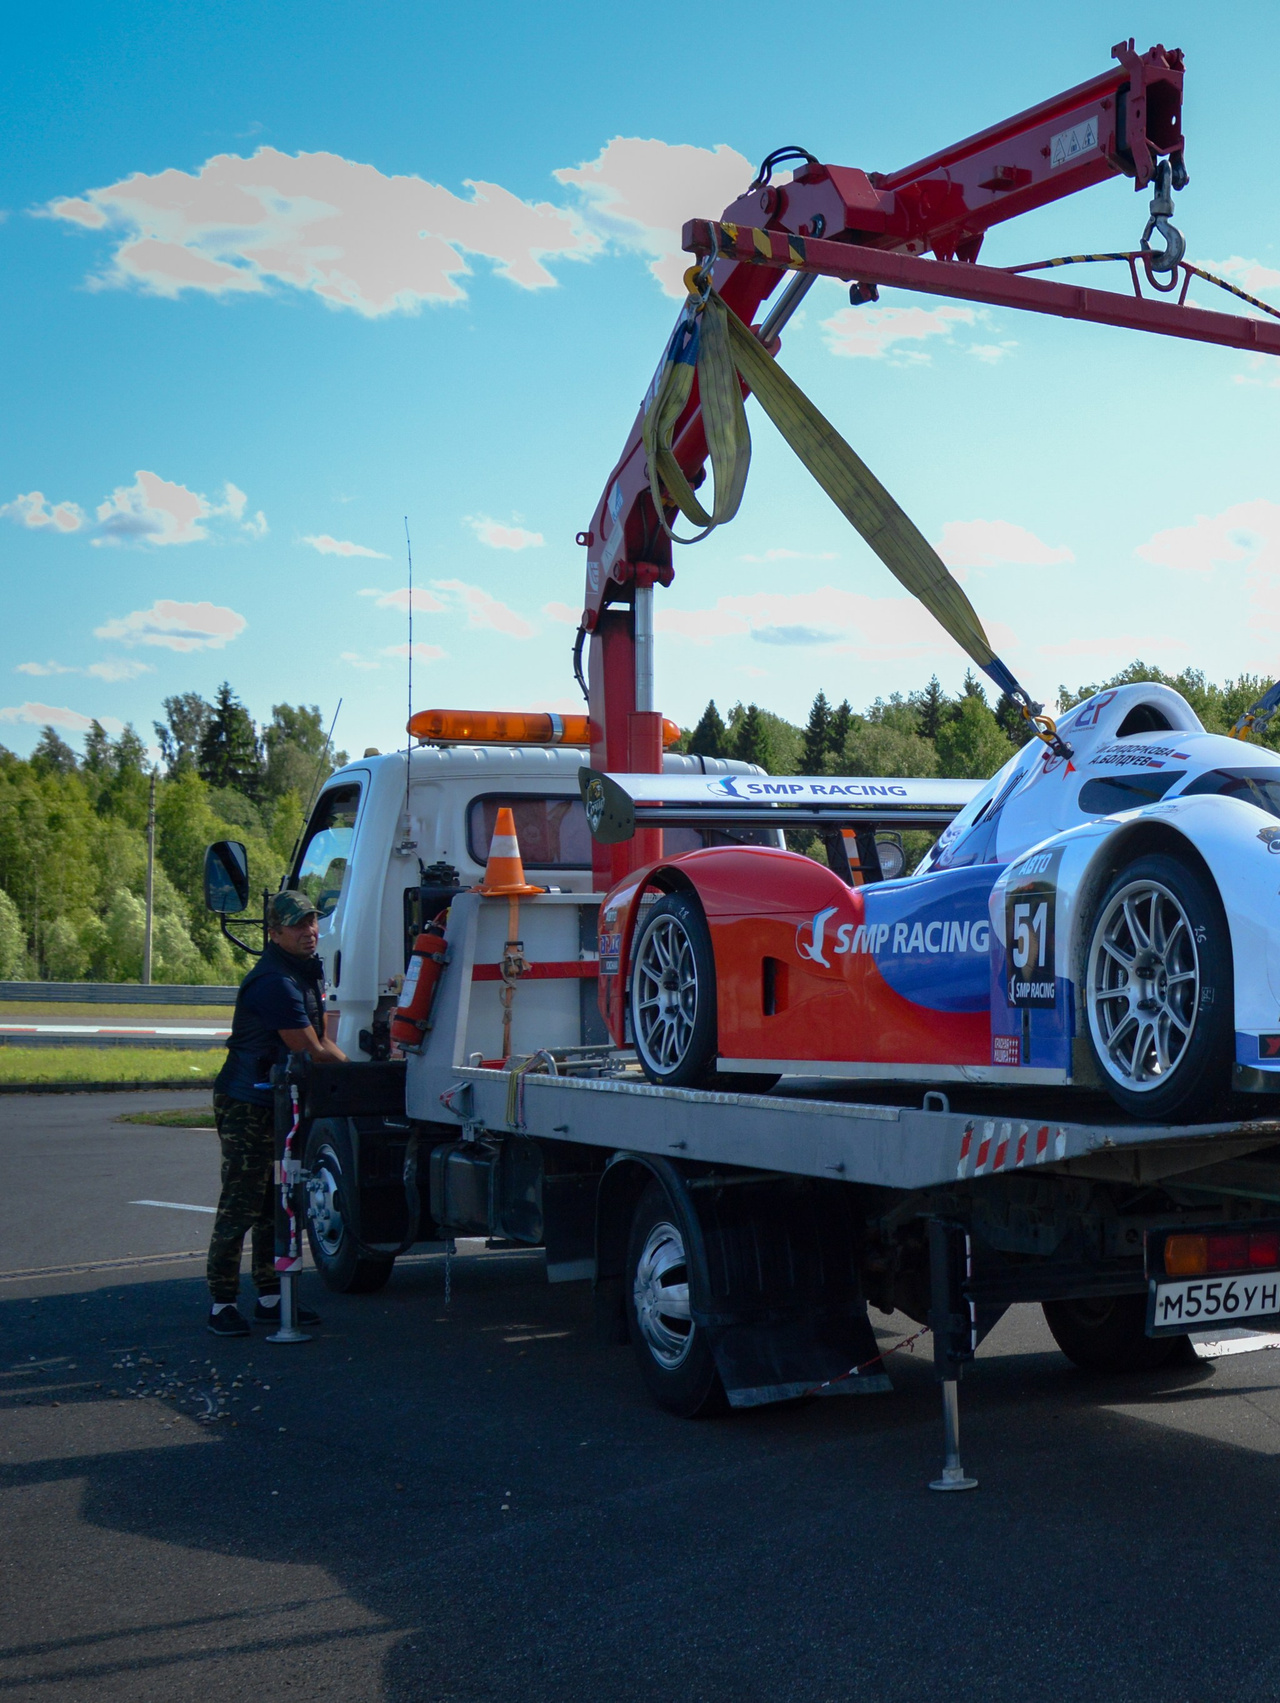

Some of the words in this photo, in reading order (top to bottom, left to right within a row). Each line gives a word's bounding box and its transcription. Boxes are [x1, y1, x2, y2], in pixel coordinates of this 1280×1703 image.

[747, 783, 804, 795] SMP
[809, 784, 907, 796] RACING
[1018, 853, 1053, 875] АВТО
[833, 923, 890, 954] SMP
[892, 920, 990, 954] RACING
[1012, 902, 1048, 968] 51
[1016, 982, 1030, 999] SMP
[1031, 982, 1055, 999] RACING
